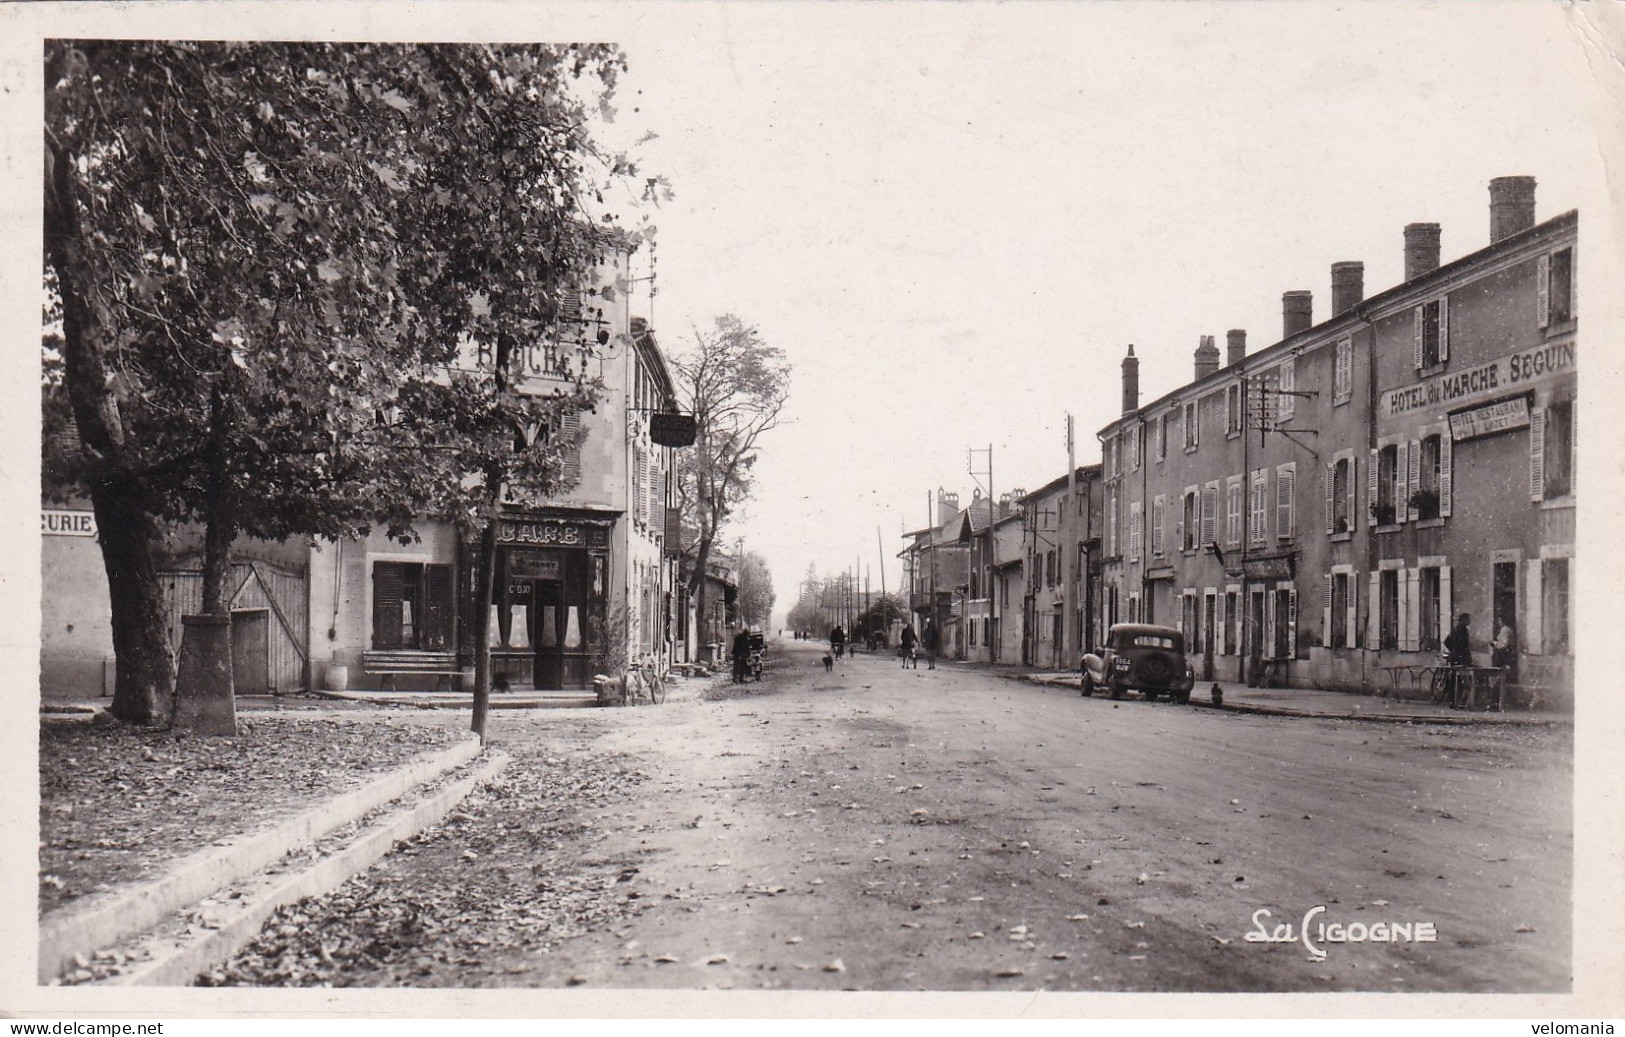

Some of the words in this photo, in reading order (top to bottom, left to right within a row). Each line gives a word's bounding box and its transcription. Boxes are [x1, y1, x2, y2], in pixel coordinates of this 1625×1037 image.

[1391, 387, 1425, 414] HOTEL
[1428, 384, 1440, 405] du
[1511, 341, 1577, 382] SEGUIN
